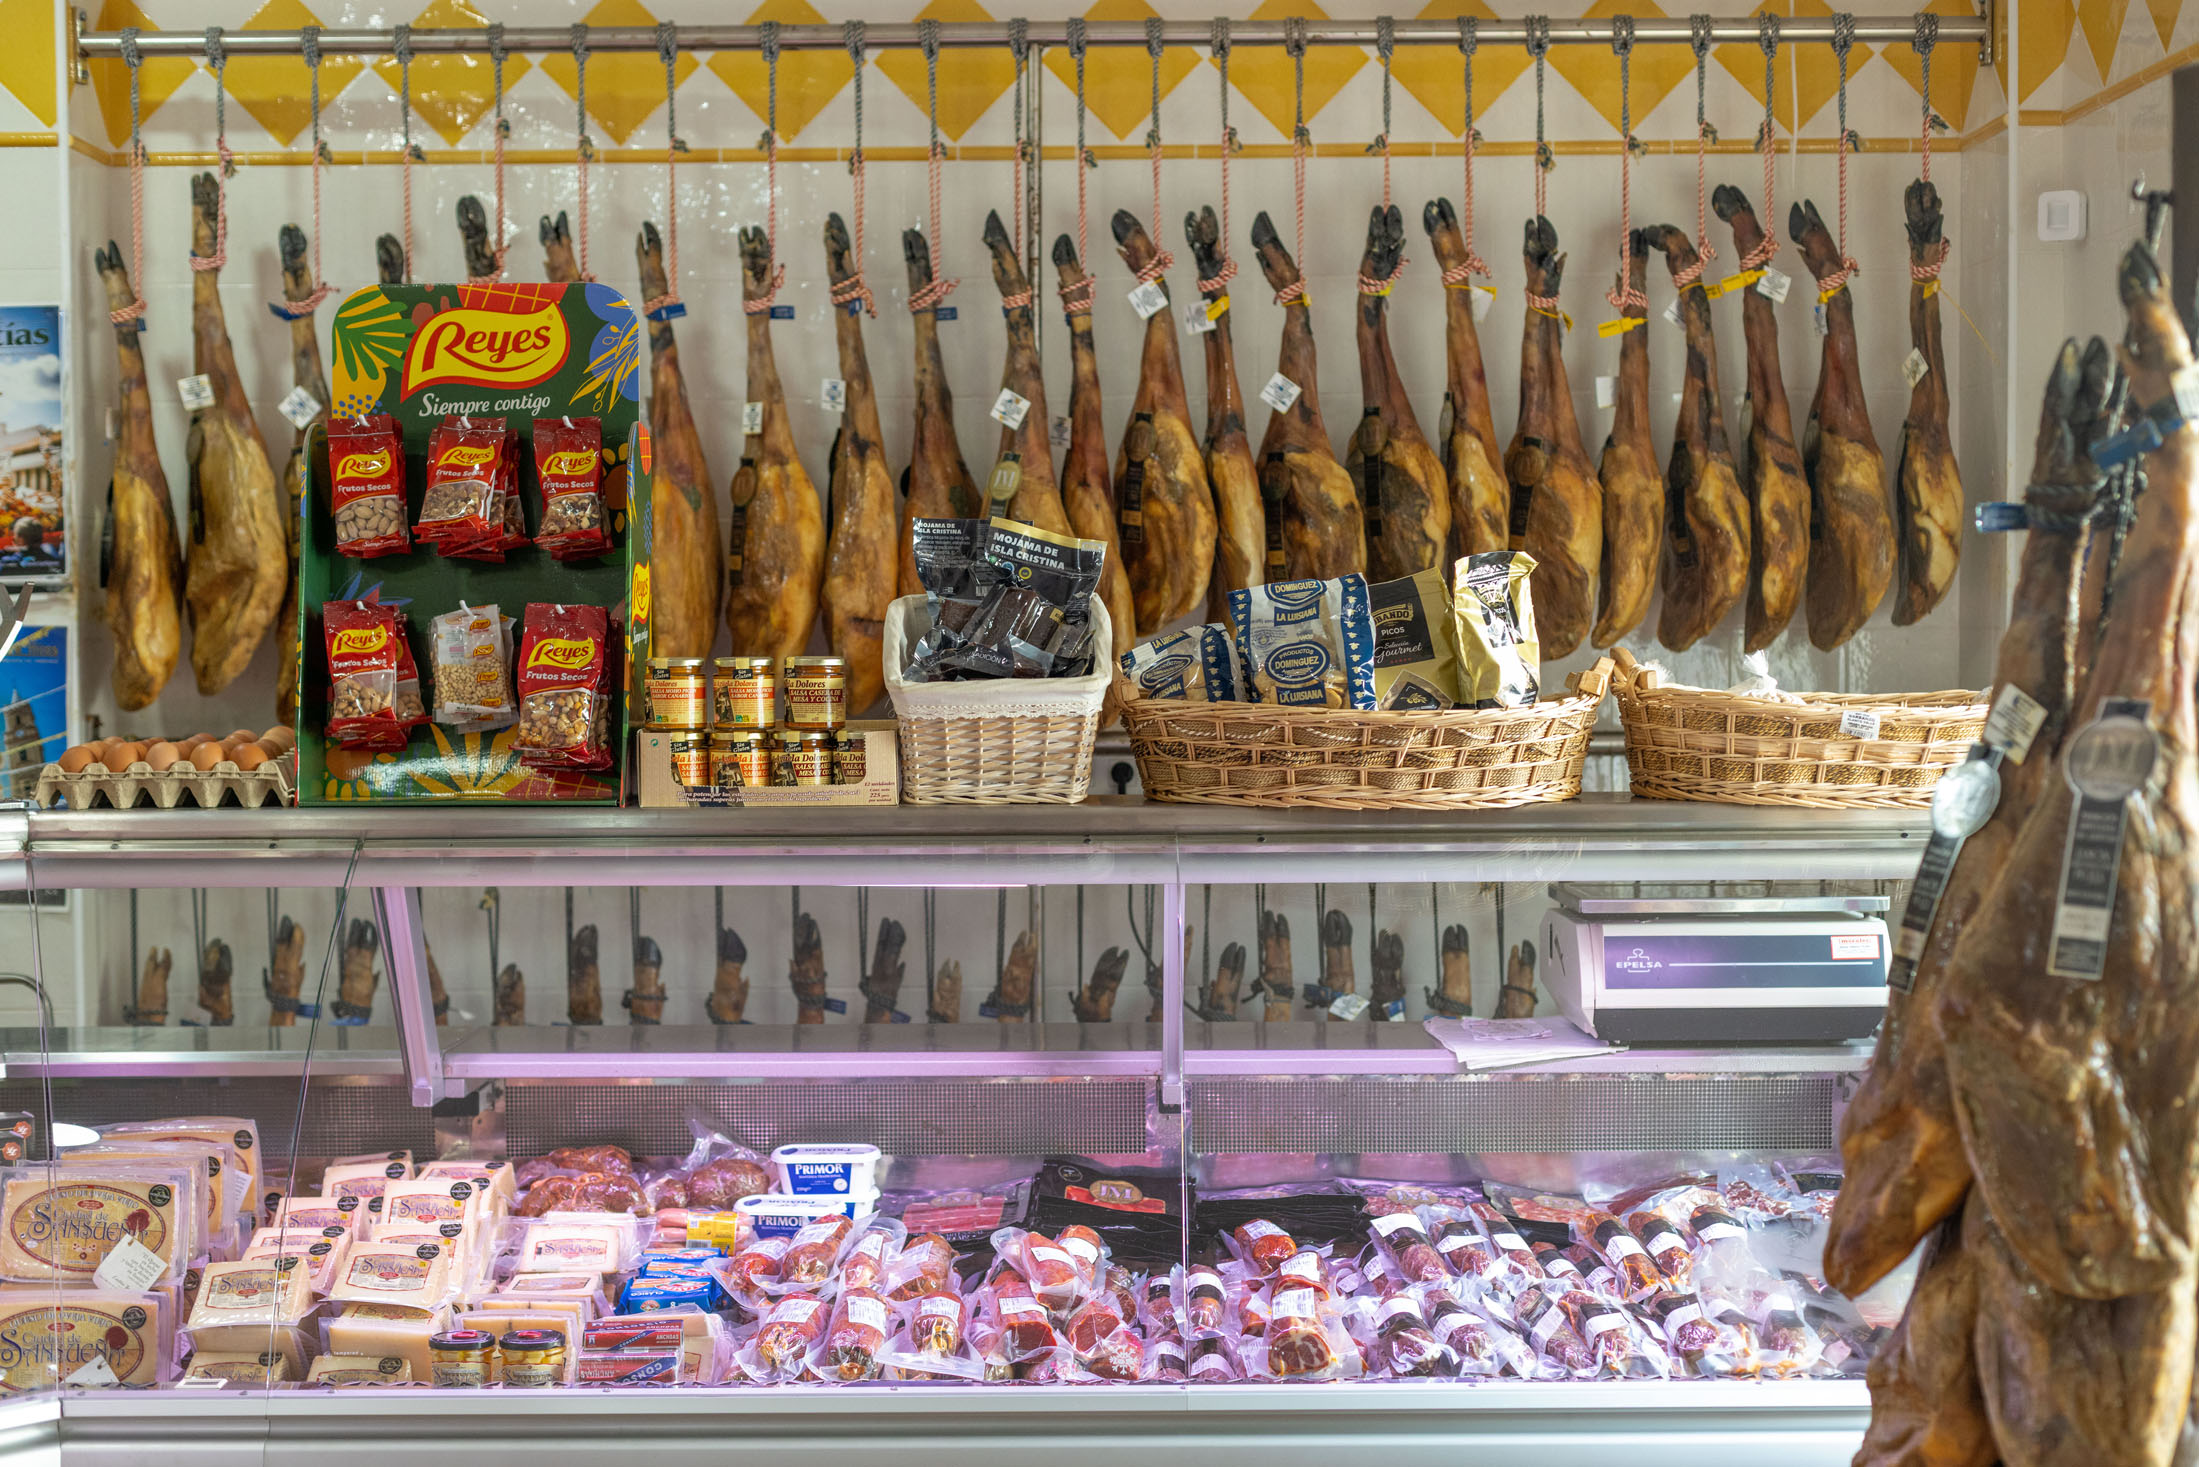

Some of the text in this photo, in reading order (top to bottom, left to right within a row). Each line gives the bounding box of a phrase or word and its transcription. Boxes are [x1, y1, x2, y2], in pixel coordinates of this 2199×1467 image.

[0, 322, 50, 346] ías
[422, 321, 551, 373] Reyes
[419, 393, 551, 417] Siempre contigo
[445, 448, 490, 464] Reyes
[338, 484, 365, 492] Frutos
[570, 480, 594, 488] Secos
[993, 532, 1058, 557] MOJAMA DE
[990, 543, 1065, 570] ISLA CRISTINA
[1274, 581, 1318, 594] DOMINGUEZ
[1276, 607, 1317, 622] LA LUISIANA
[1381, 626, 1405, 636] PICOS
[336, 632, 382, 652] Reyes
[1152, 639, 1162, 649] LA
[535, 642, 590, 665] Reyes
[1279, 648, 1314, 660] PRODUCTOS
[1374, 642, 1422, 664] Gourmet
[1275, 656, 1319, 670] DOMINGUEZ
[526, 671, 588, 681] Frutos Secos
[795, 679, 826, 688] Dolores
[1280, 688, 1323, 703] LA LUISIANA
[1615, 961, 1662, 969] EPELSA
[795, 1163, 844, 1175] PRIMOR
[1100, 1184, 1133, 1199] JM
[95, 1212, 109, 1222] de
[67, 1333, 82, 1343] de
